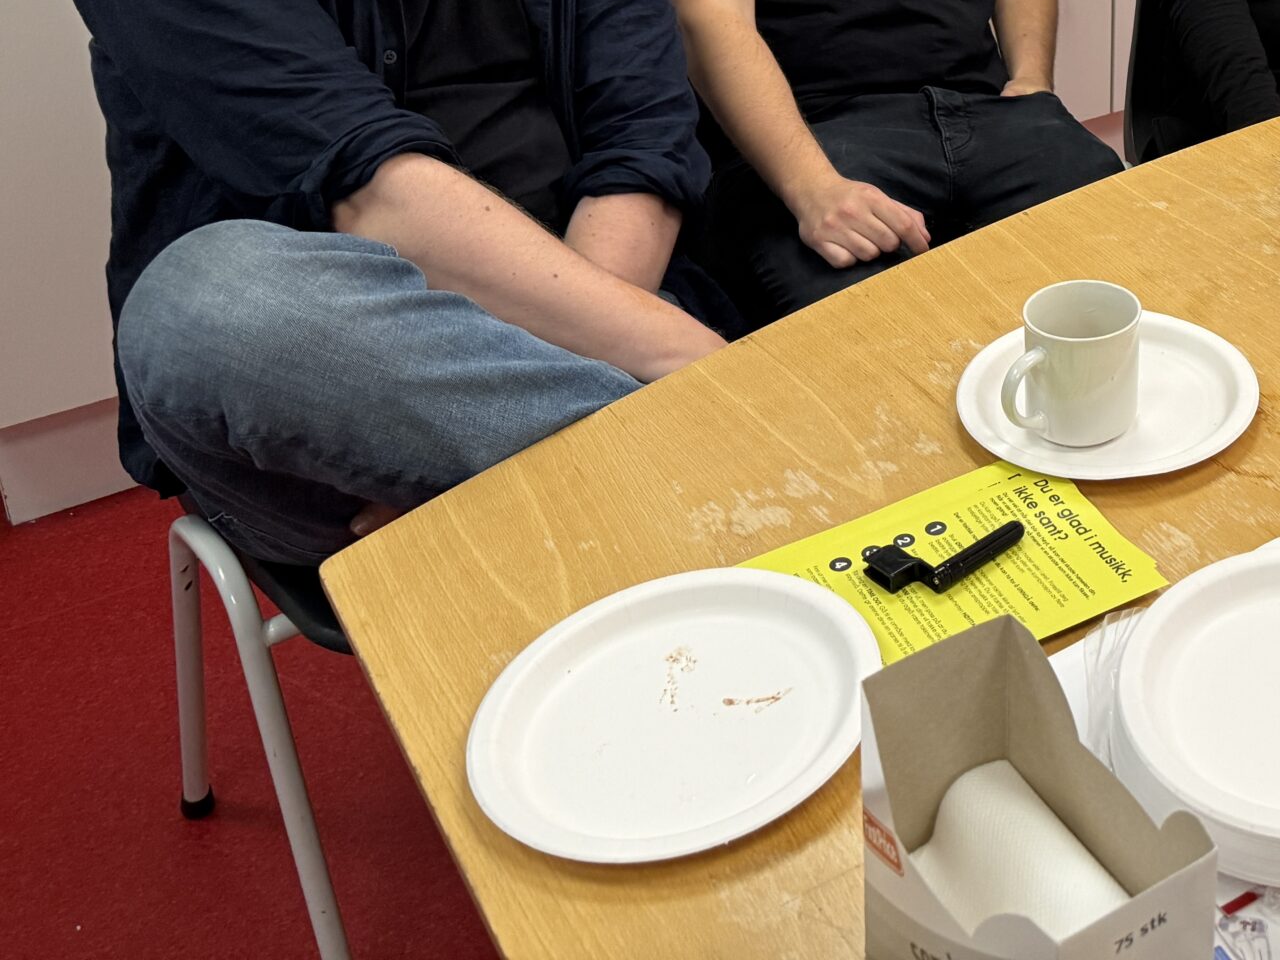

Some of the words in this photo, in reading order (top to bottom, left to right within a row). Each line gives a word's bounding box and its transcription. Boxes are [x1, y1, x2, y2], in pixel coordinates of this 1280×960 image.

[1033, 477, 1053, 494] Du
[1048, 494, 1065, 506] er
[1012, 485, 1038, 510] ikke
[1034, 510, 1069, 541] sant?
[930, 524, 942, 533] 1
[1056, 508, 1092, 536] glad
[896, 536, 910, 545] 2
[1083, 534, 1098, 542] i
[1089, 541, 1132, 583] musikk,
[1115, 930, 1138, 954] 75
[1140, 912, 1168, 936] stk
